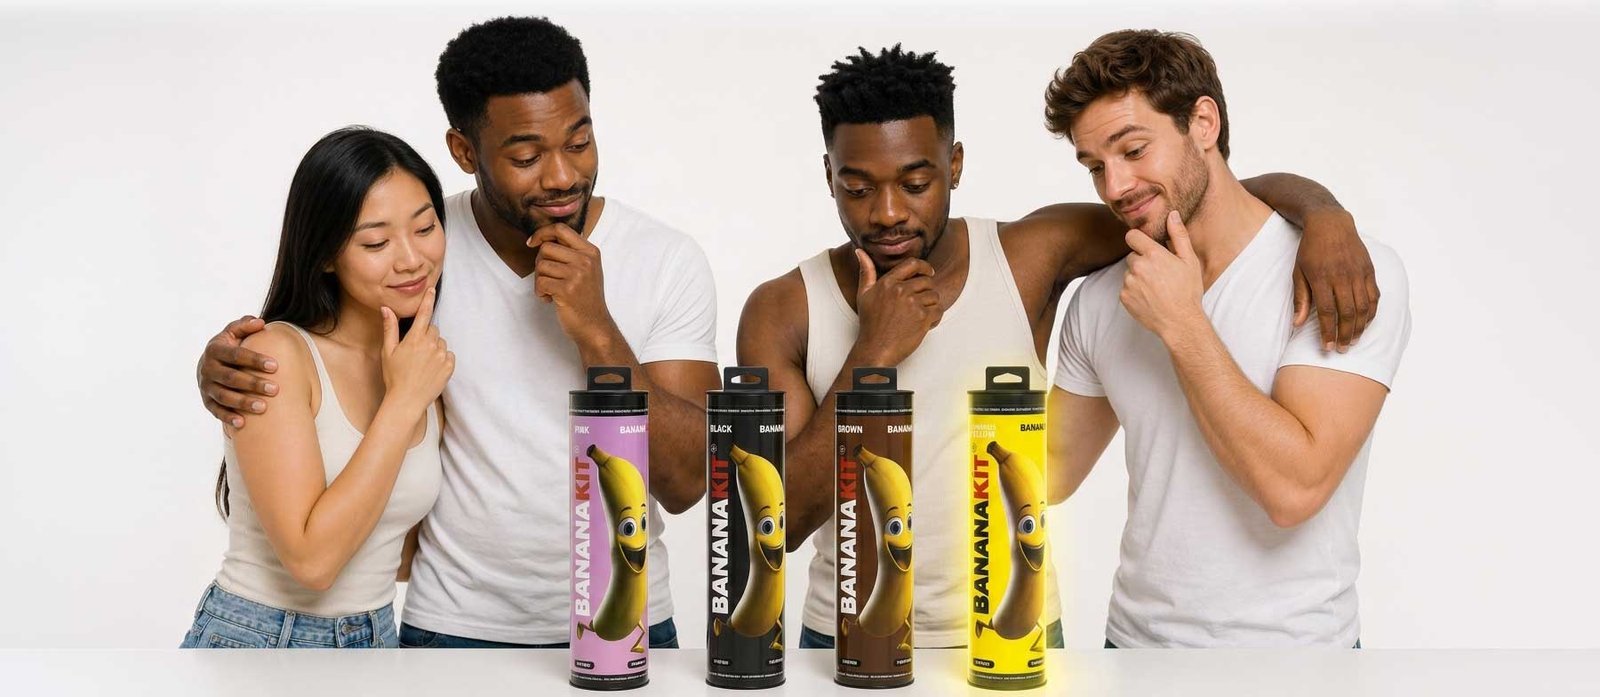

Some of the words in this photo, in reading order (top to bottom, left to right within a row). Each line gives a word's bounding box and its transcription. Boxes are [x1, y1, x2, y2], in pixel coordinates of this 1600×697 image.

[574, 425, 590, 434] PINK
[710, 424, 732, 433] BLACK
[837, 424, 863, 434] BROWN
